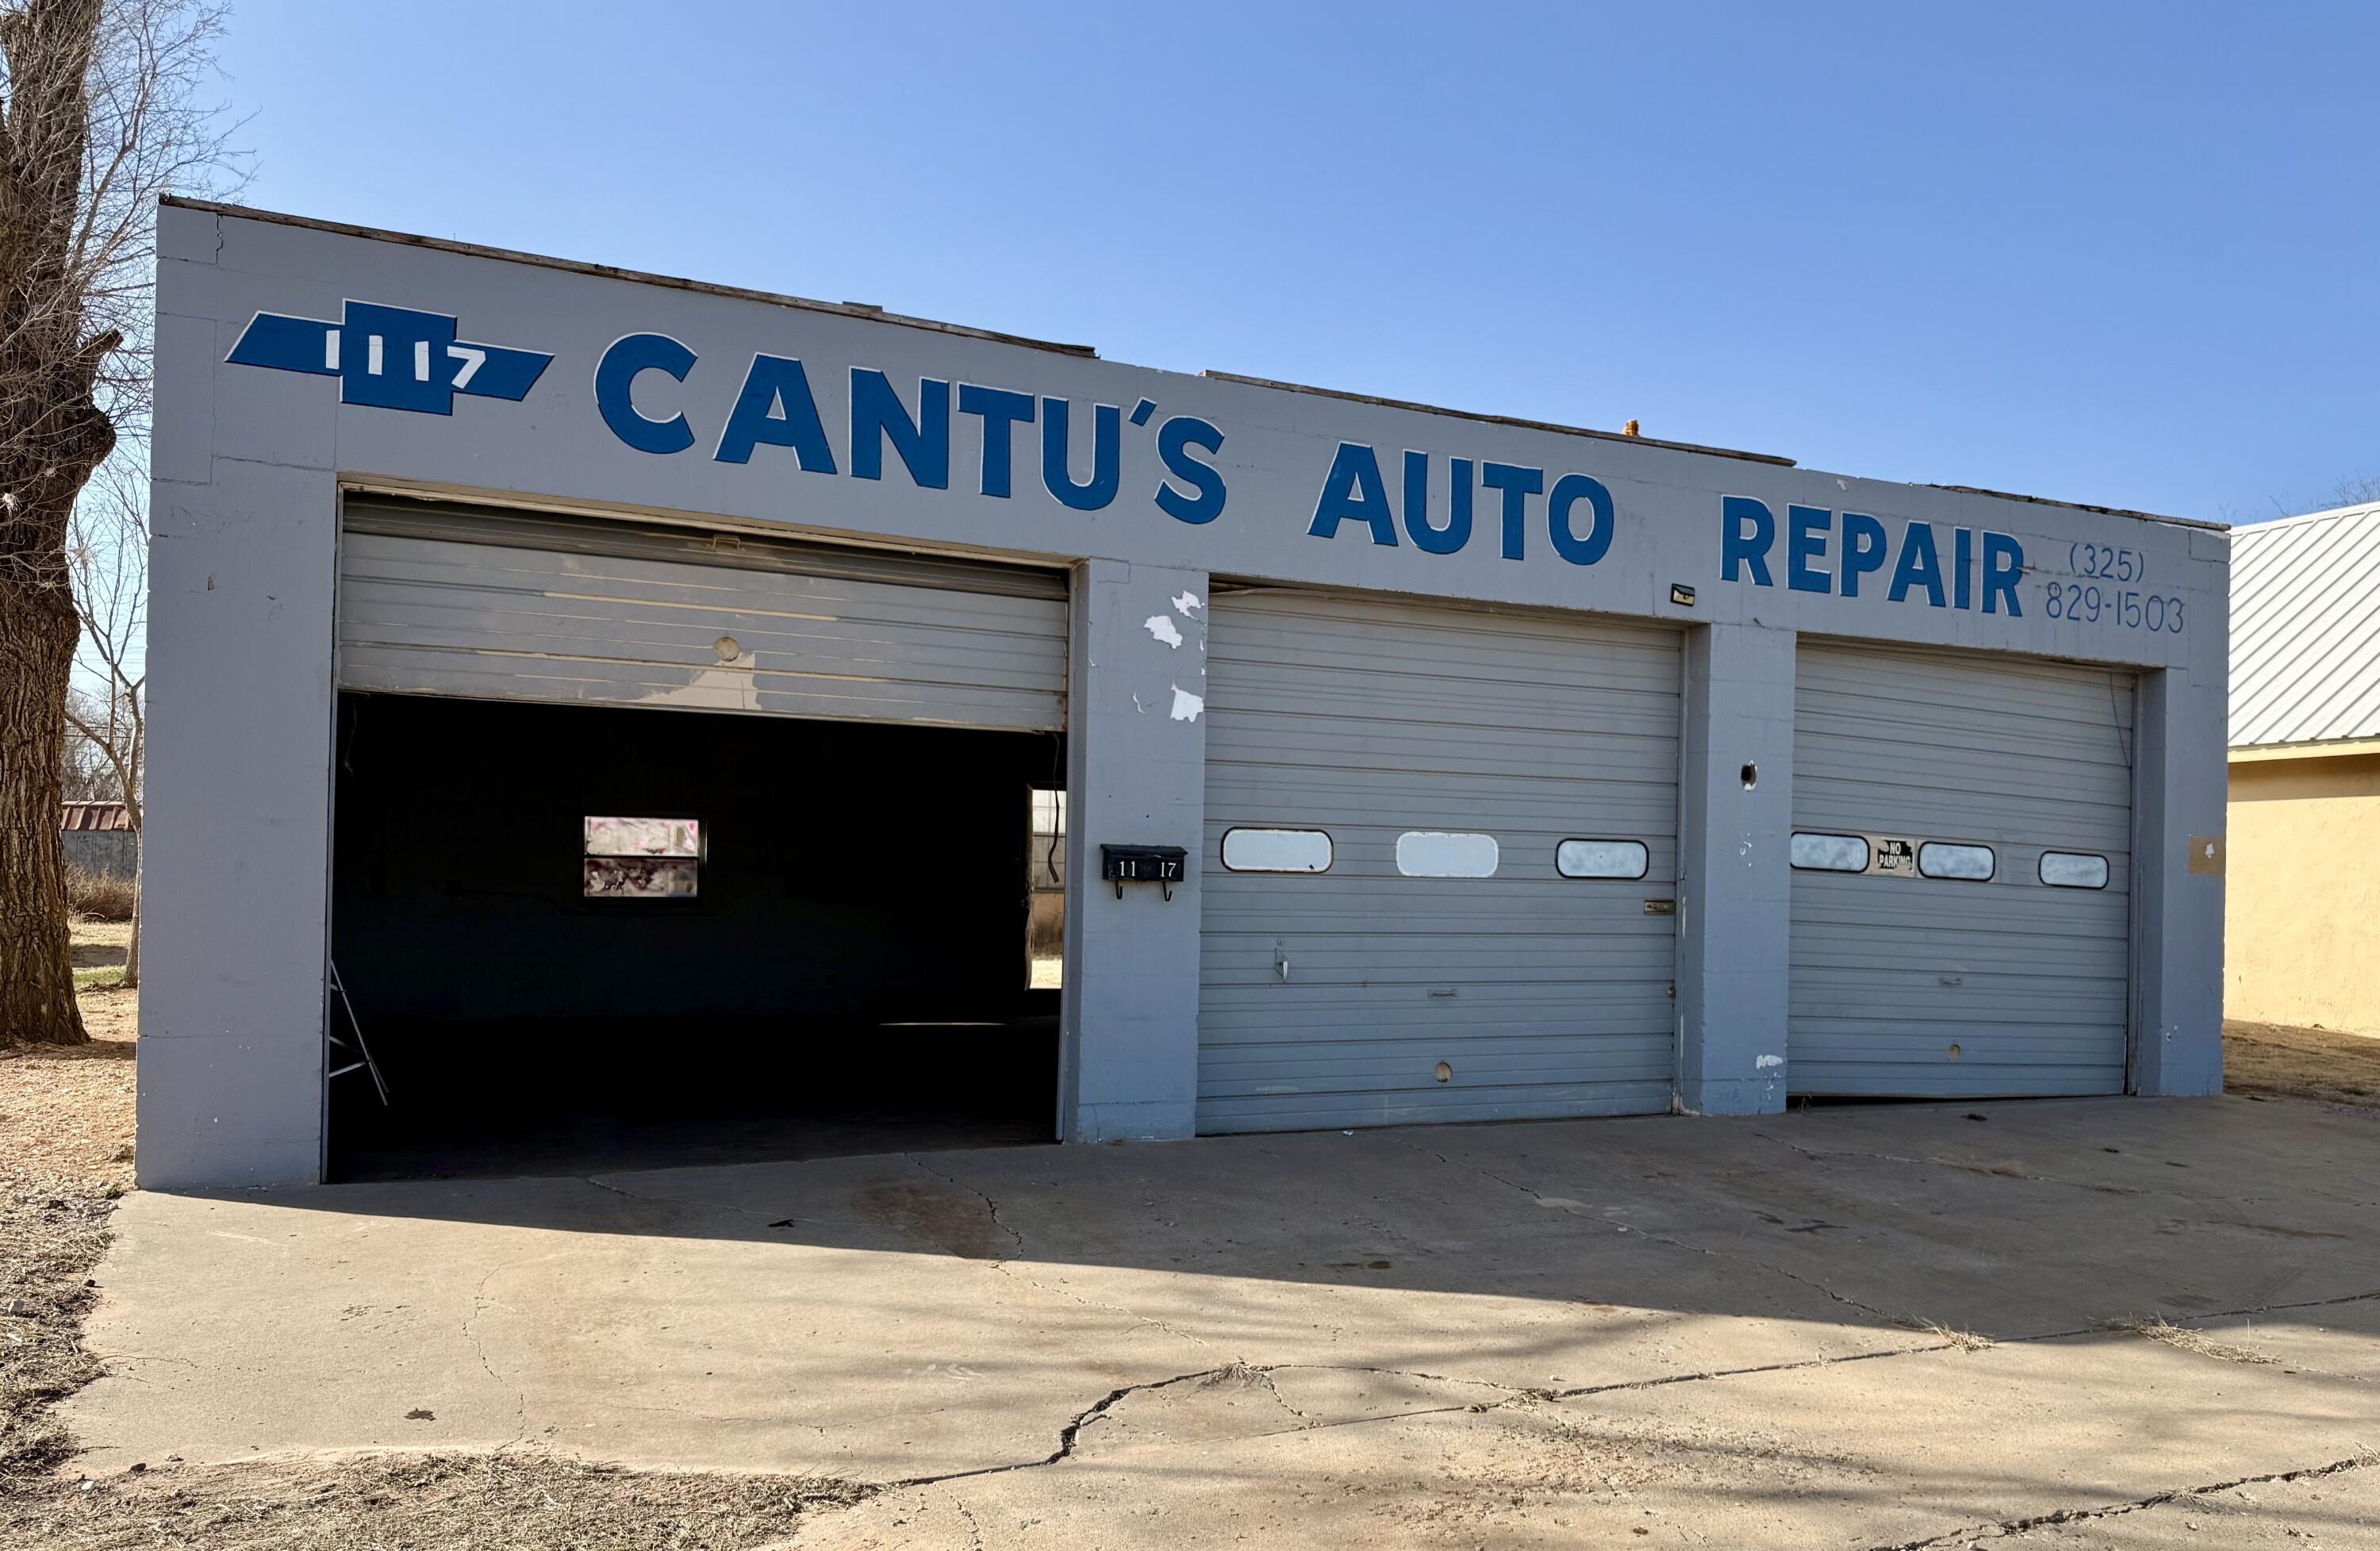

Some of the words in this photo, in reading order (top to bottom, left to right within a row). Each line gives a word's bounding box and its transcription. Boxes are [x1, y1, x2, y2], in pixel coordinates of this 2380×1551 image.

[325, 329, 486, 389] 1117
[593, 331, 1226, 525] CANTU'S
[1307, 441, 1614, 565] AUTO
[1719, 493, 2024, 617] REPAIR
[2069, 542, 2144, 582] (325)
[2045, 582, 2185, 634] 829-1503
[1879, 854, 1911, 867] PARKING
[1890, 842, 1901, 854] NO
